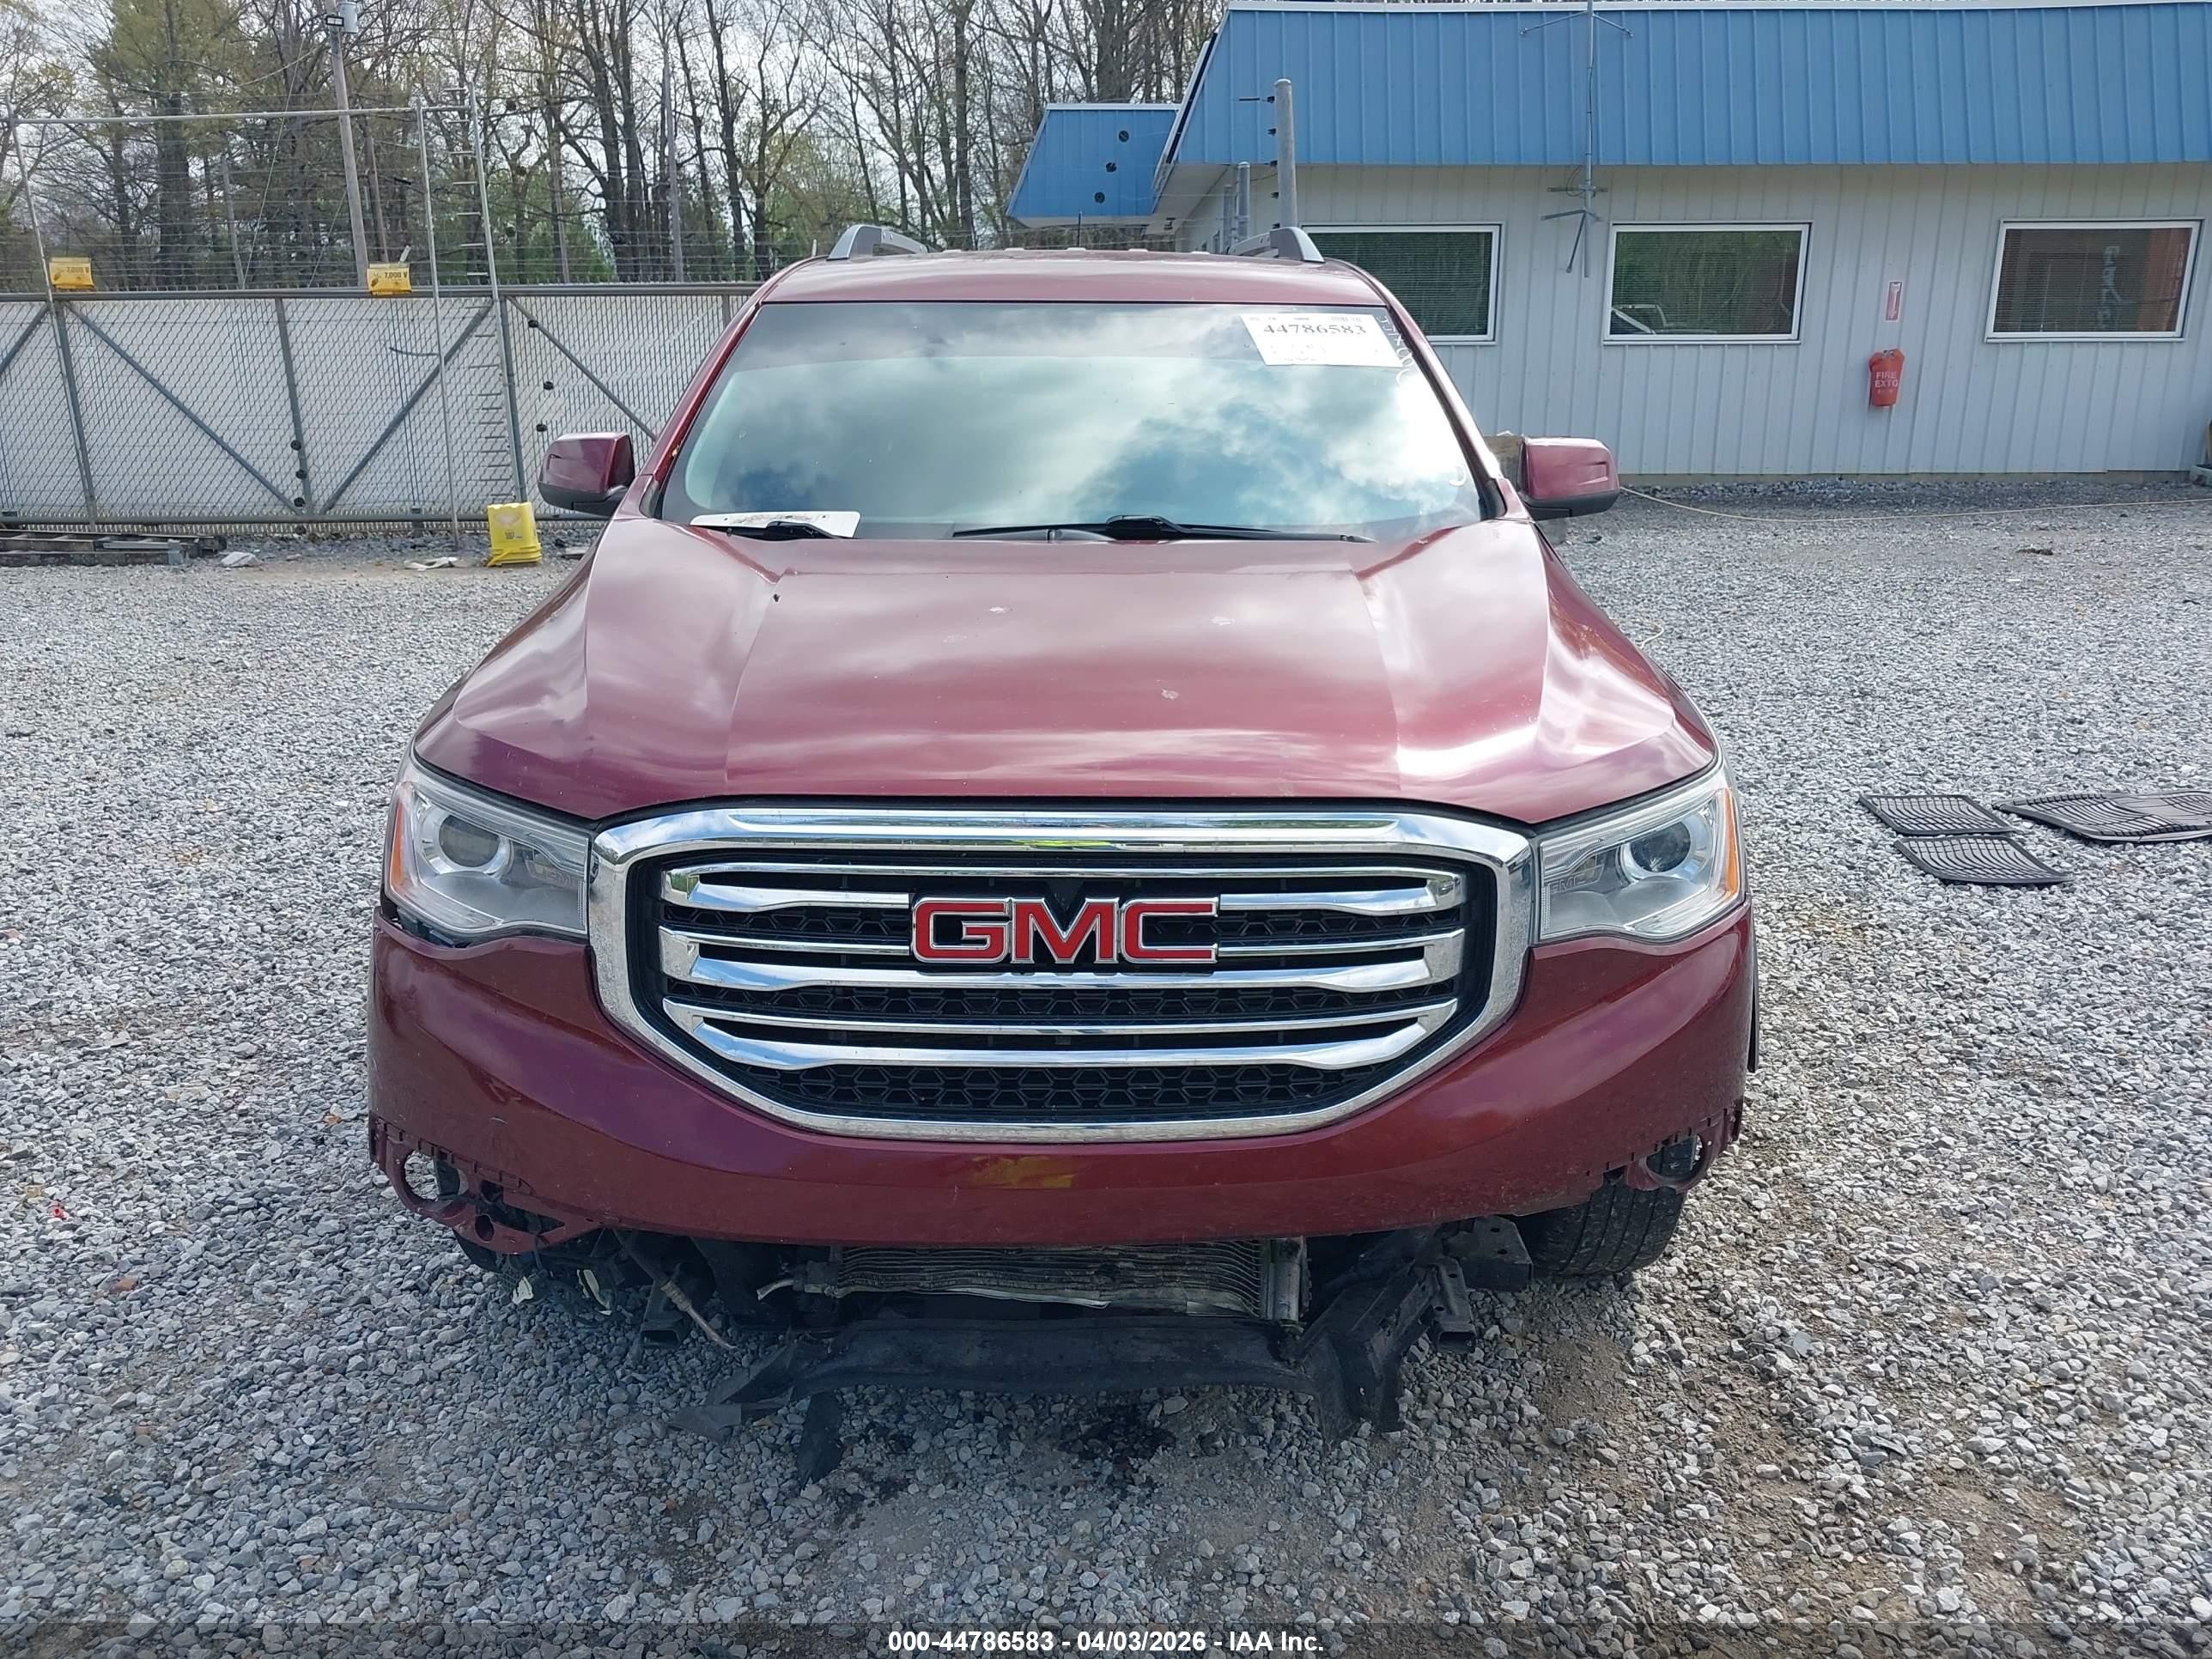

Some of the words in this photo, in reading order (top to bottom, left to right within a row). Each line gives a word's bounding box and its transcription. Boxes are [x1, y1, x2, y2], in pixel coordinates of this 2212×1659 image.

[1263, 324, 1367, 335] 44786583
[1875, 371, 1897, 380] FIRE
[912, 897, 1218, 963] GMC
